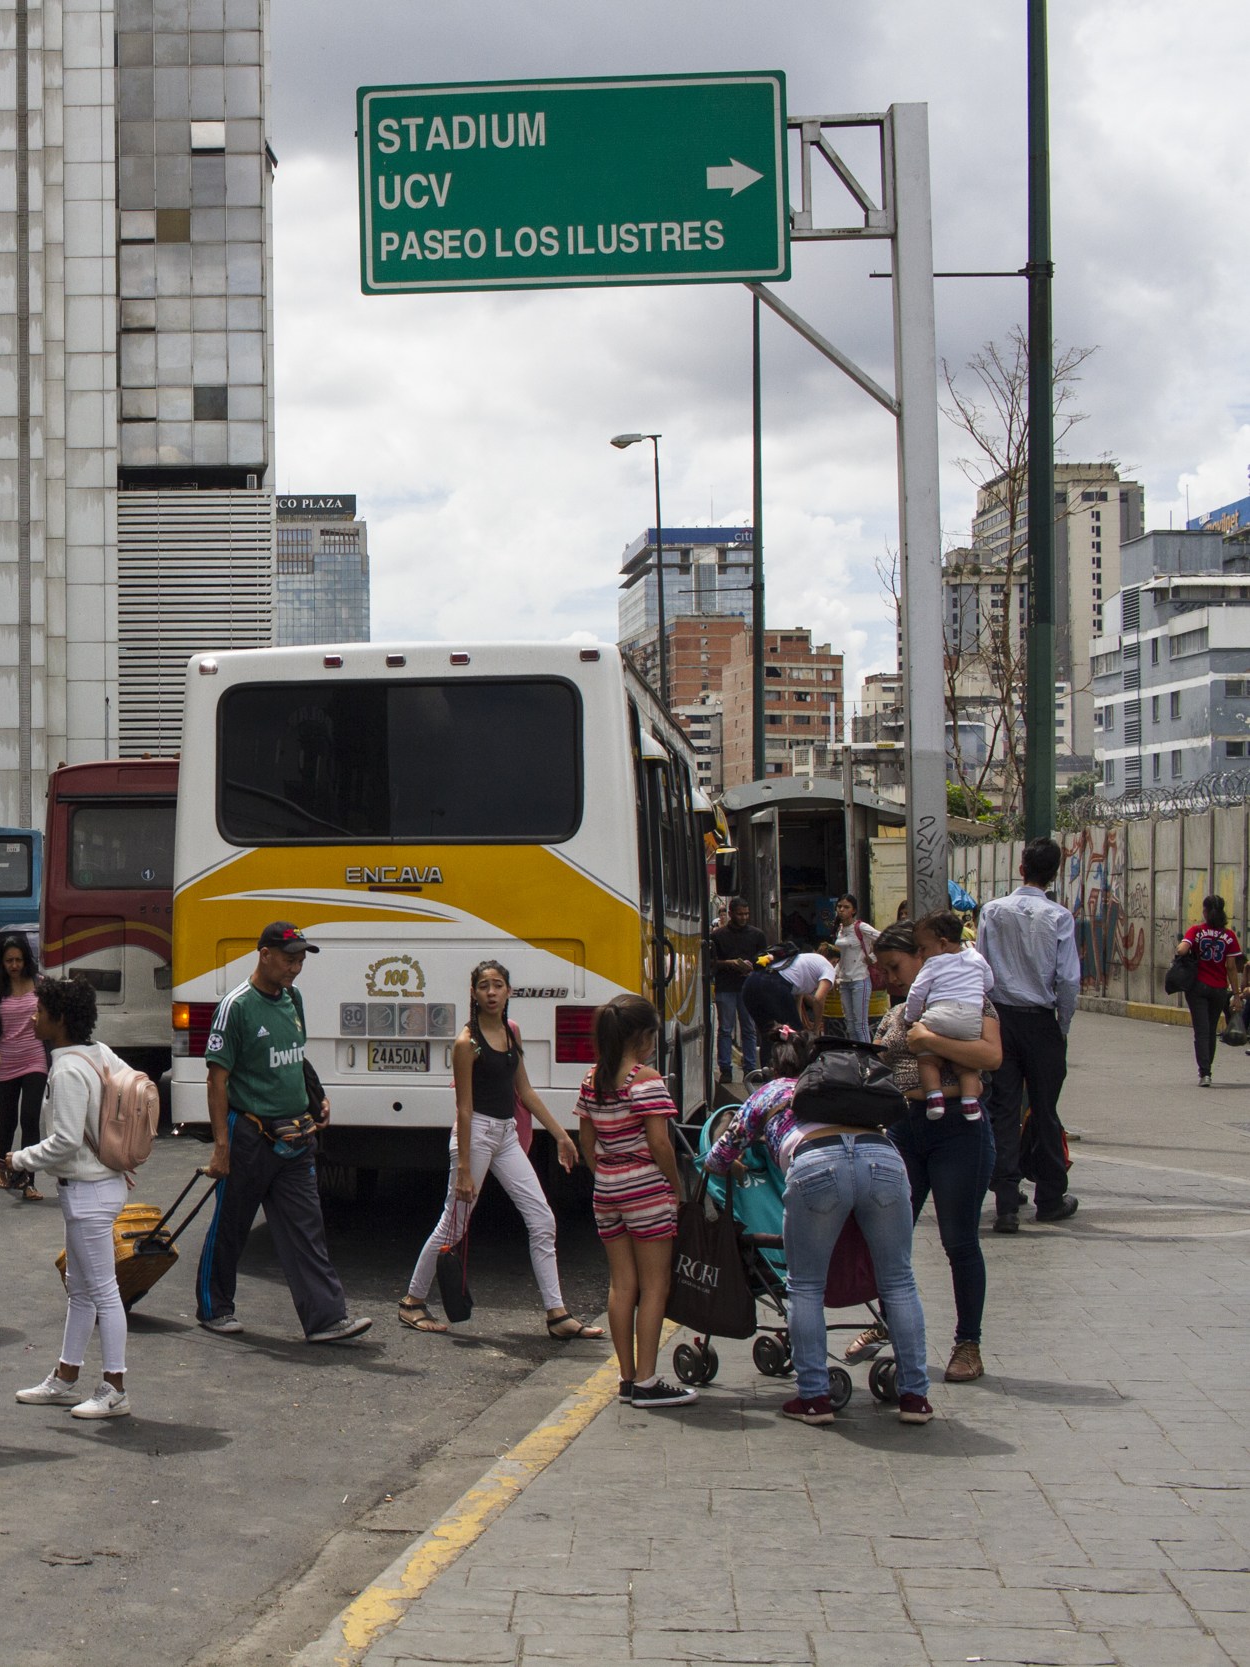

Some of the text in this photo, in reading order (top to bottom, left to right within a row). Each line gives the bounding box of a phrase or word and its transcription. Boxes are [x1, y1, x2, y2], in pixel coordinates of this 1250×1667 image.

[377, 112, 546, 154] STADIUM
[378, 173, 452, 210] UCV
[380, 219, 725, 261] PASEO LOS ILUSTRES
[301, 499, 343, 509] PLAZA
[345, 866, 443, 883] ENCAVA
[384, 969, 409, 986] 105
[344, 1009, 363, 1022] 80
[372, 1048, 426, 1064] 24A50AA
